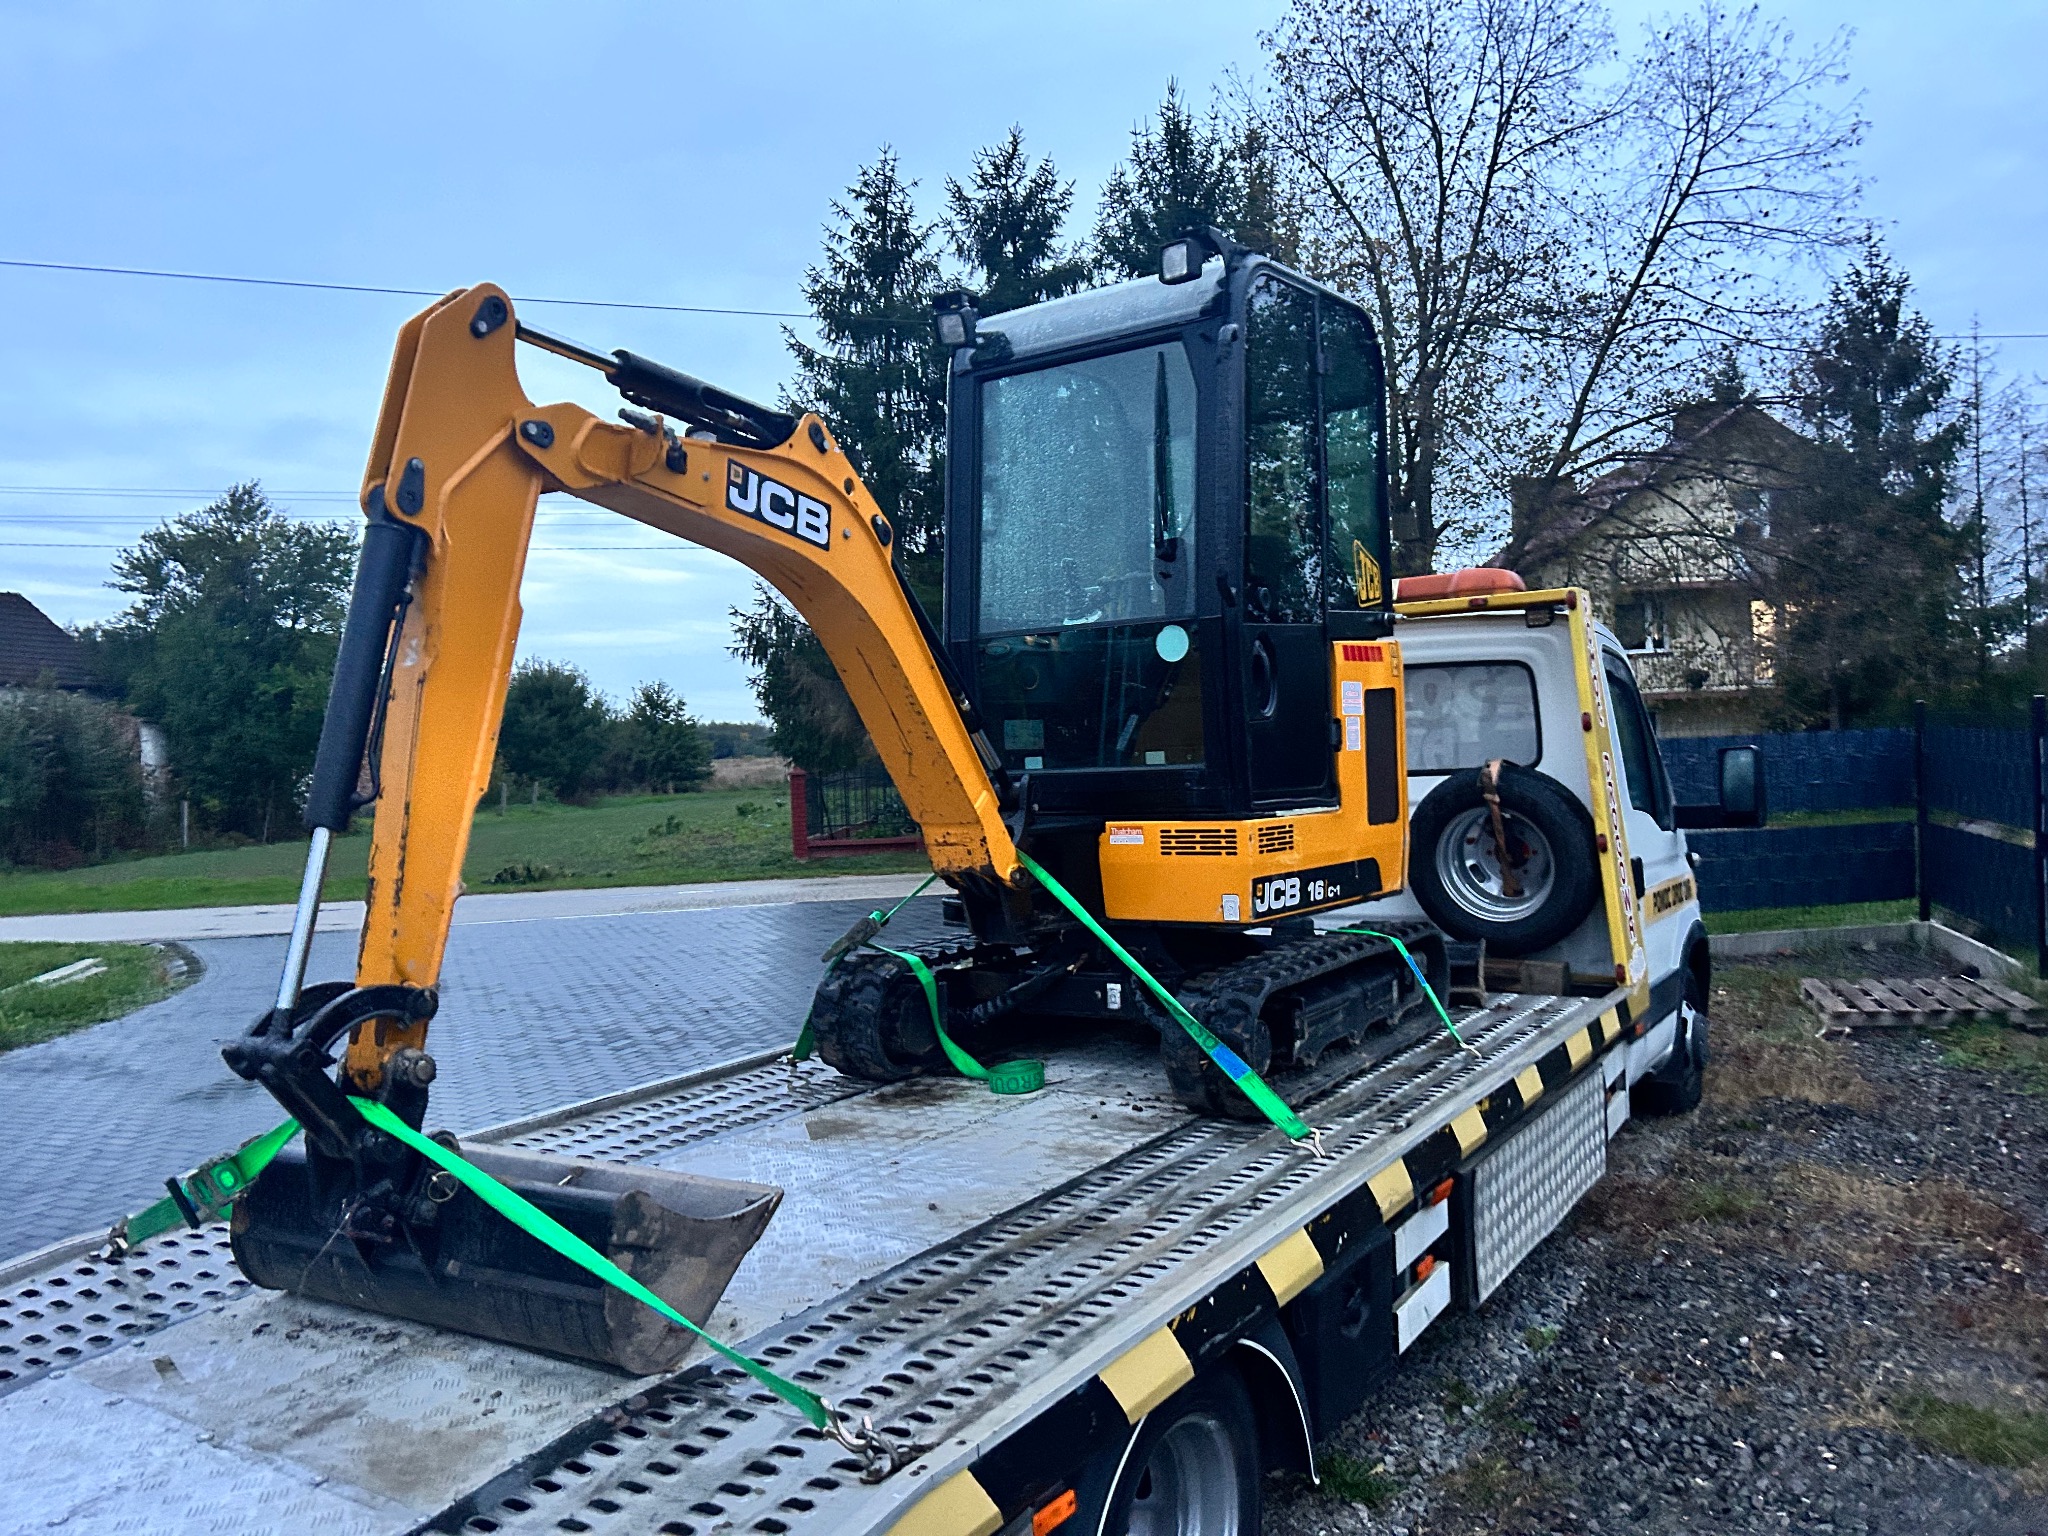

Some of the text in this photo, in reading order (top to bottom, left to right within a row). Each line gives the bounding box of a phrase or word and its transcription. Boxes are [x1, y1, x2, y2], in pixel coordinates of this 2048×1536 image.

[729, 471, 829, 545] JCB
[1358, 550, 1380, 601] JCB
[1111, 827, 1143, 835] Thatcham
[1256, 877, 1300, 912] JCB
[1308, 880, 1324, 901] 16
